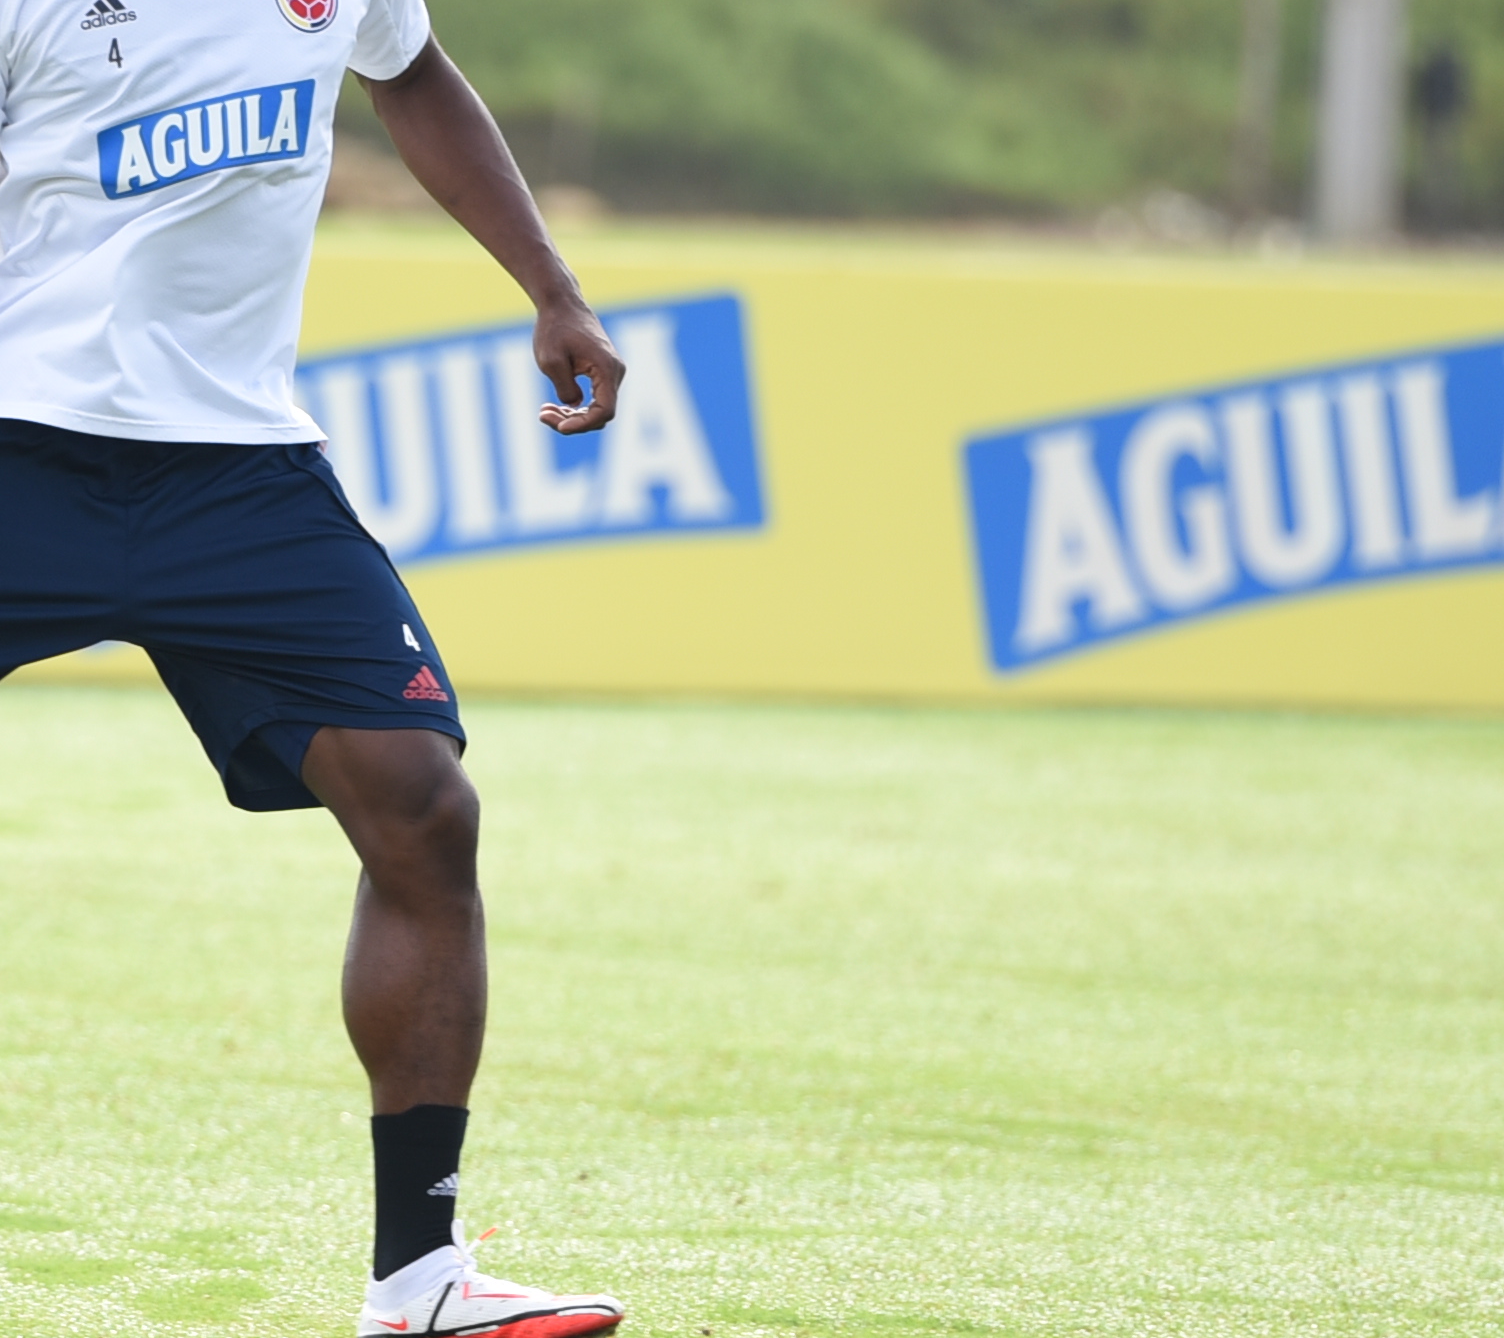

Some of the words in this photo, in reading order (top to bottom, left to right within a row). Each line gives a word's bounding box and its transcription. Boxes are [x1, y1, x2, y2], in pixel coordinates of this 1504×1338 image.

[80, 10, 138, 31] adidas
[108, 37, 124, 69] 4
[115, 88, 300, 194] AGUILA
[294, 309, 736, 560] UILA
[402, 623, 422, 652] 4
